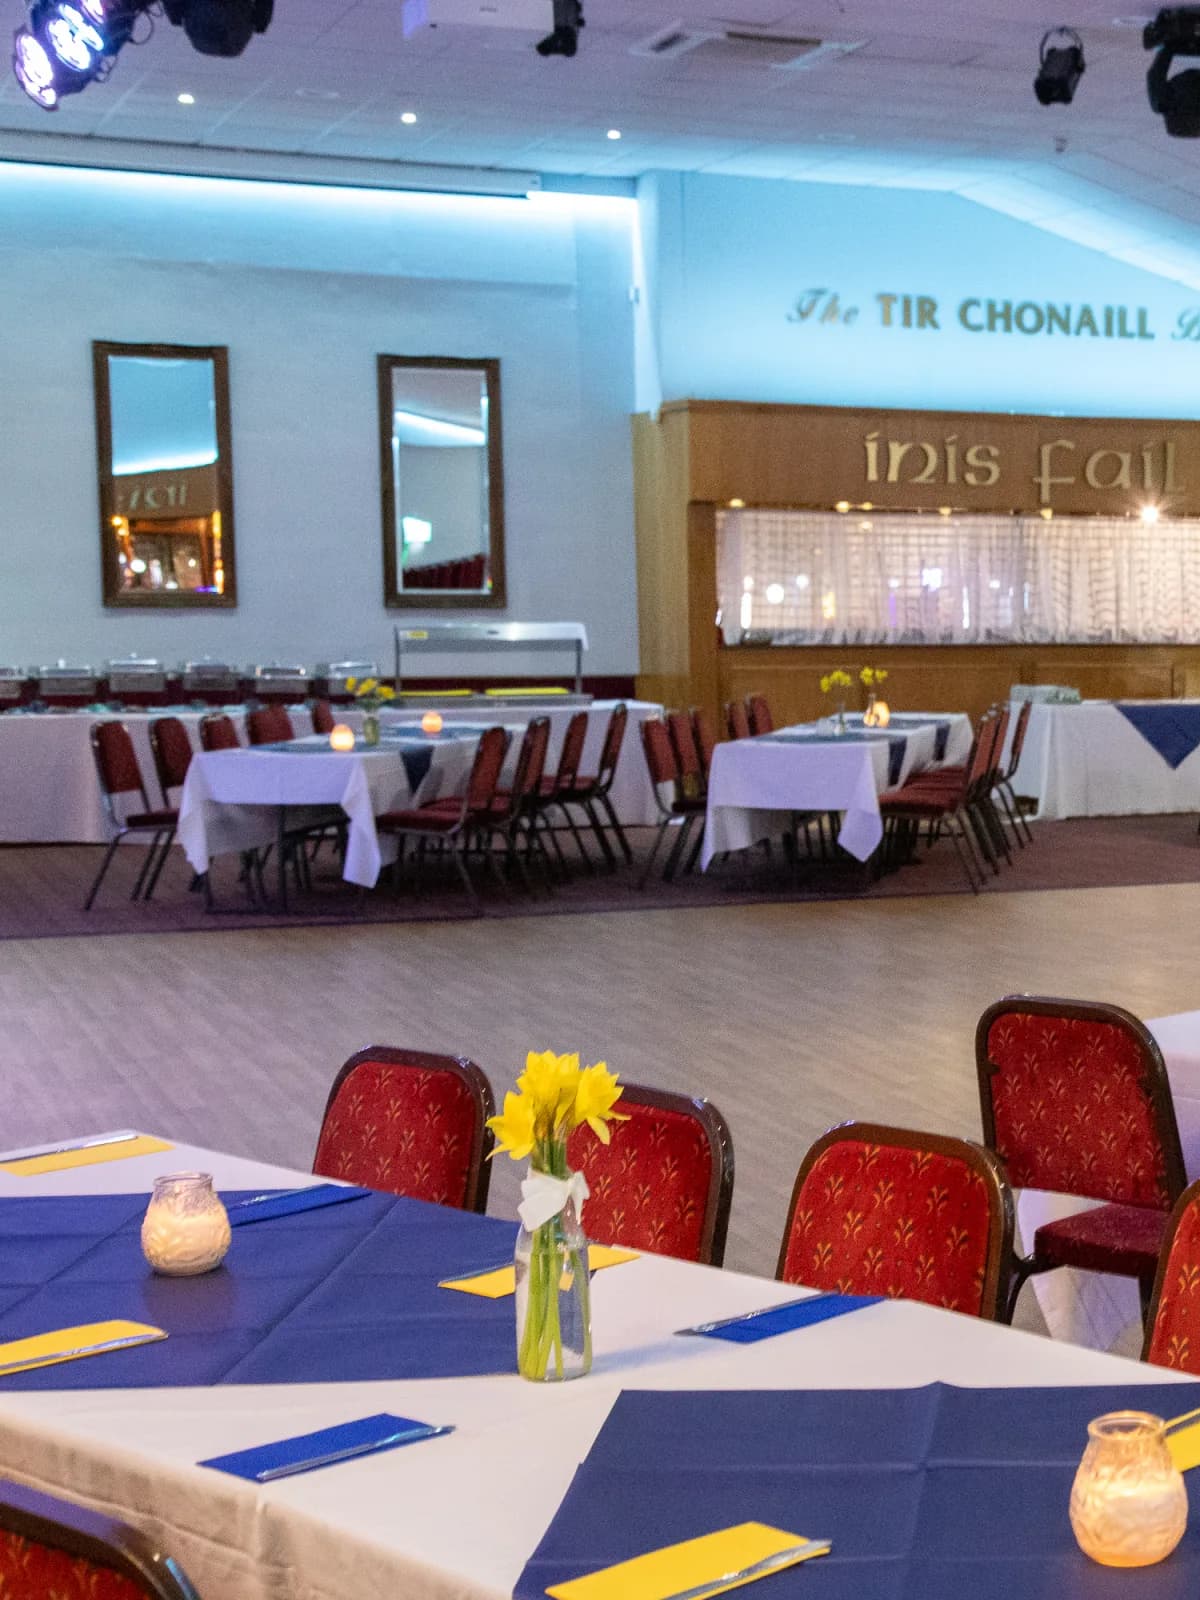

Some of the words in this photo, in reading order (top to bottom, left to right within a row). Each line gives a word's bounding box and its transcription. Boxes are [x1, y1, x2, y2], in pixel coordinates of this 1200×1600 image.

[785, 287, 859, 324] The
[875, 292, 941, 330] TIR
[958, 298, 1155, 340] CHONAILL
